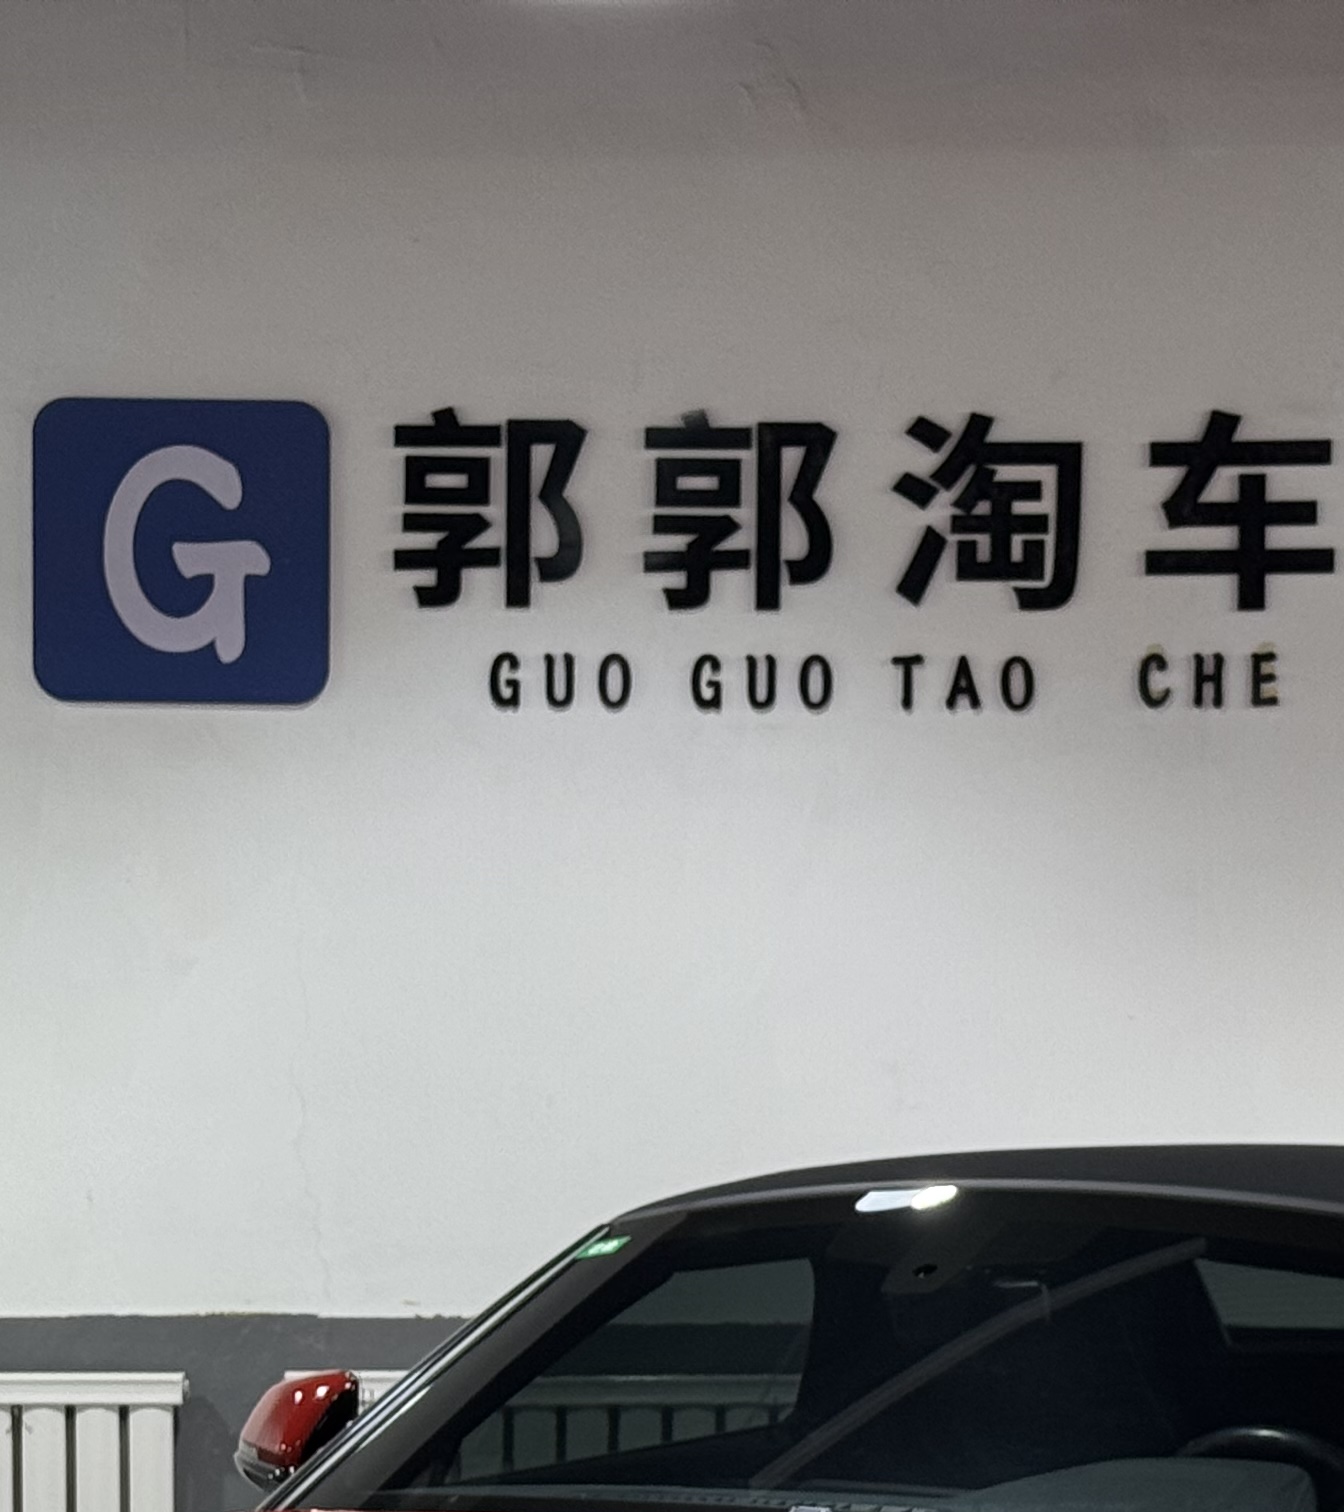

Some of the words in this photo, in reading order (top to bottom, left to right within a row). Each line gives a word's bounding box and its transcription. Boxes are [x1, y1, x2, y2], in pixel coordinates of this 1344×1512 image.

[102, 443, 273, 665] G
[392, 406, 1337, 613] 郭郭淘车
[488, 651, 633, 710] GUO
[690, 653, 836, 711] GUO
[890, 652, 1037, 713] TAO
[1136, 648, 1282, 710] CHE
